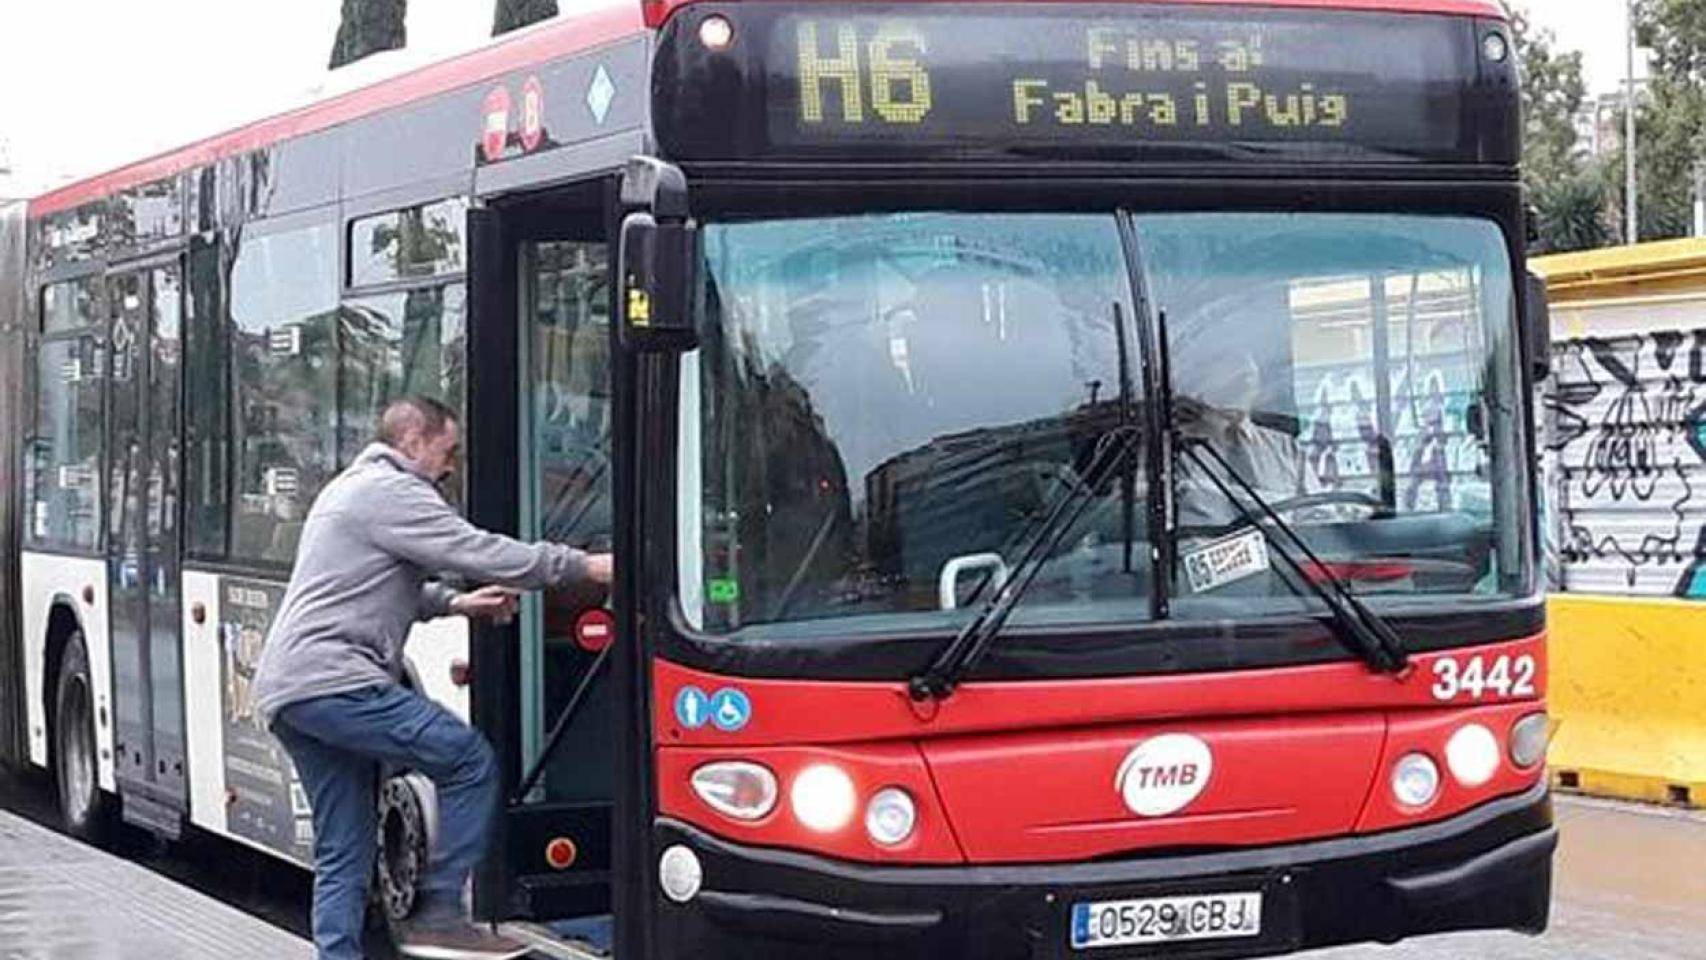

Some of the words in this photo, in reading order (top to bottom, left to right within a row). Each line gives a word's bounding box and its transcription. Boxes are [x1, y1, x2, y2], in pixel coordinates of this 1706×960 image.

[1087, 26, 1199, 71] Fins
[797, 20, 931, 122] H6
[1013, 79, 1176, 124] Fabra
[1195, 81, 1209, 124] i
[1227, 83, 1347, 126] Puig
[1432, 655, 1535, 699] 3442
[1139, 763, 1198, 788] TMB
[1099, 904, 1178, 940] 0529
[1190, 898, 1247, 932] CBJ
